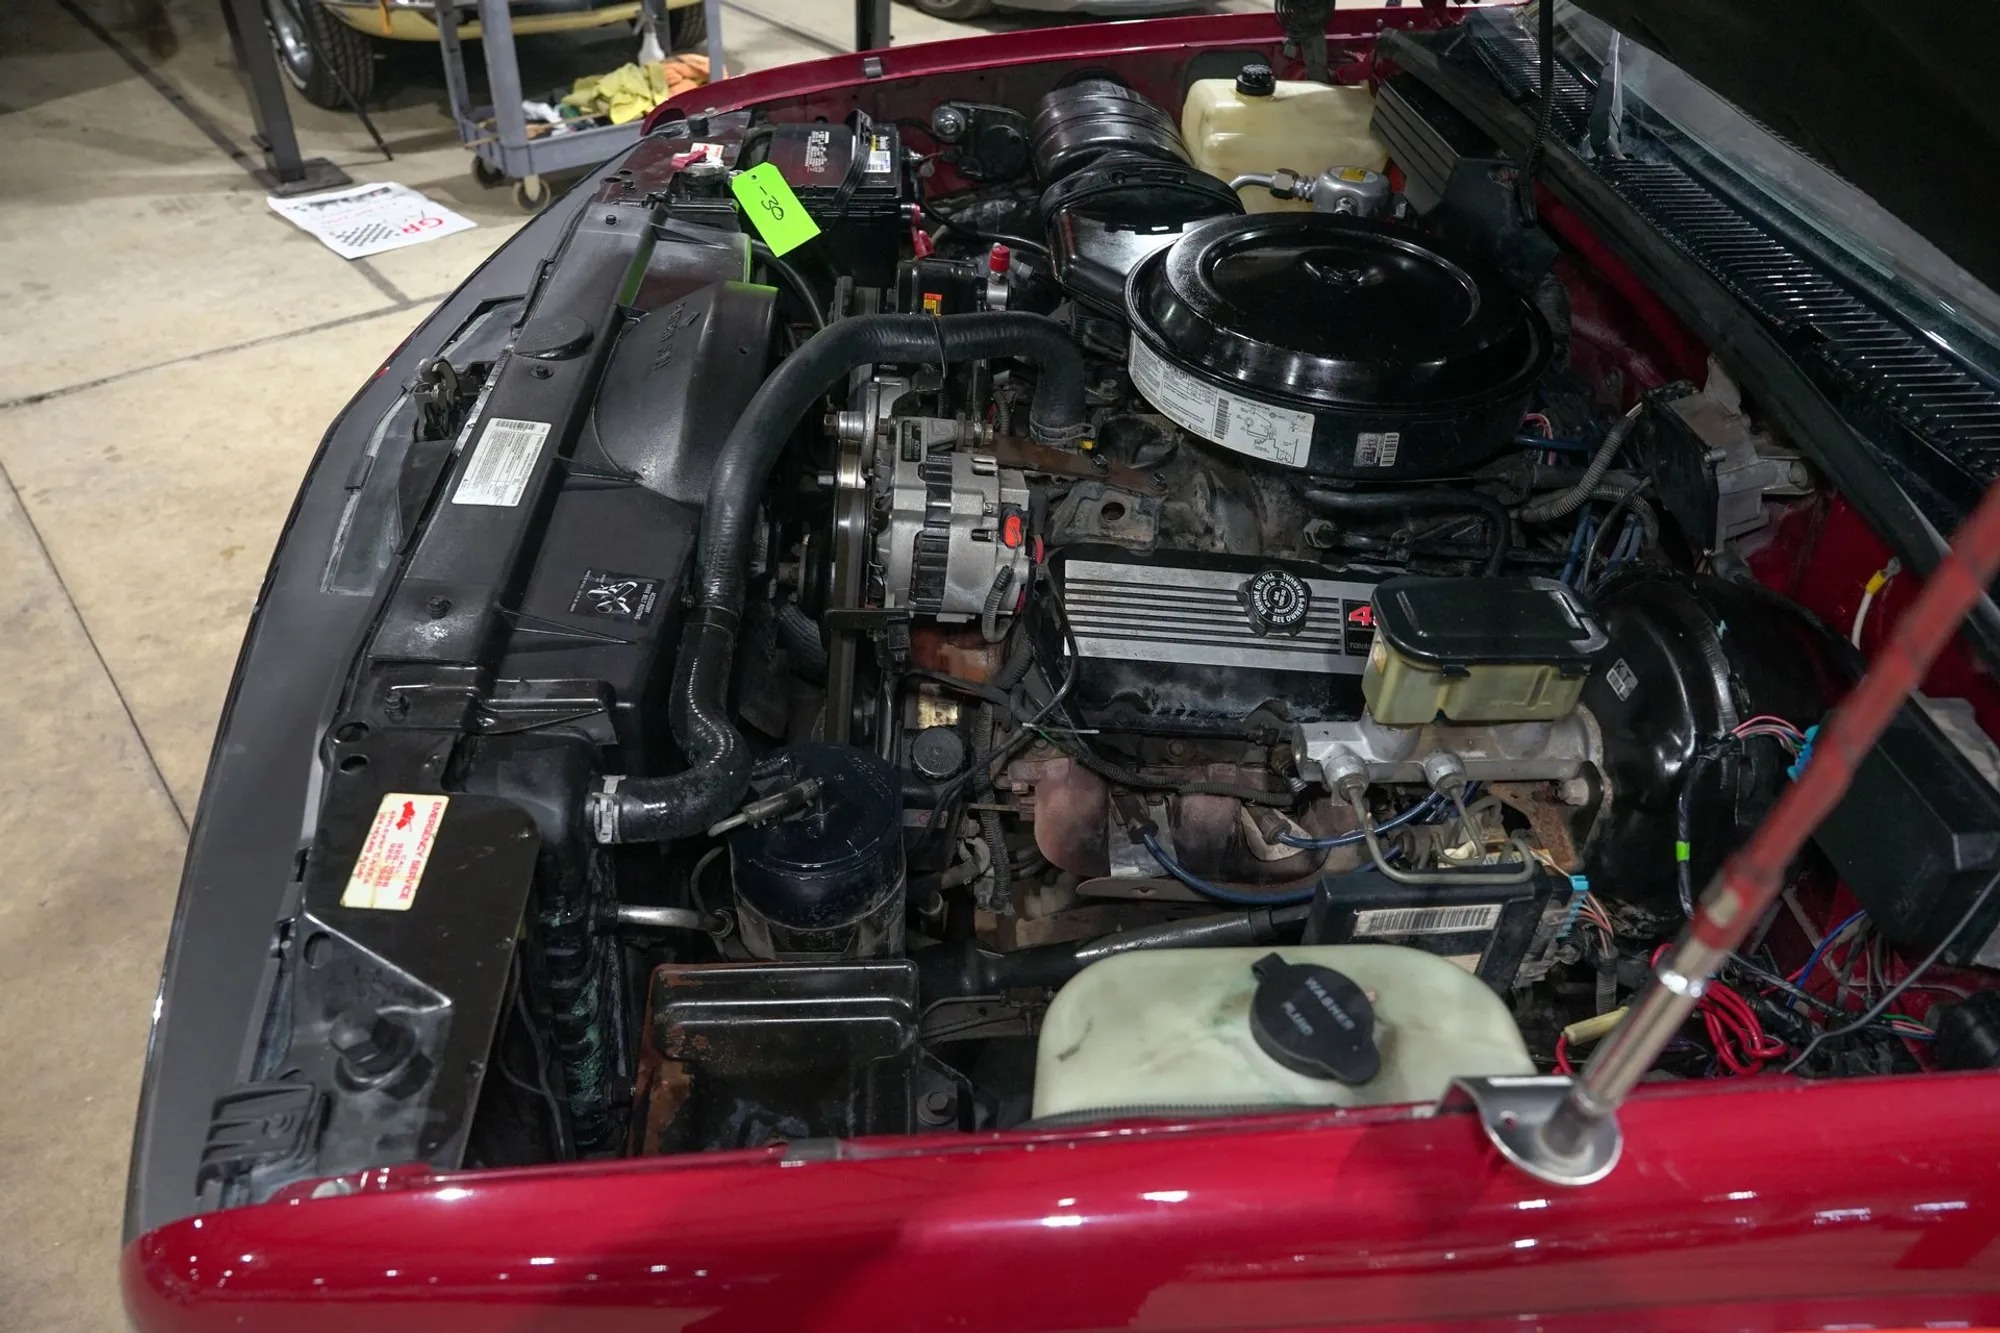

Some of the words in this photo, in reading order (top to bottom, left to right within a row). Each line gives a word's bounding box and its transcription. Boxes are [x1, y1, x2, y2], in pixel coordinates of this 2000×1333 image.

[1255, 580, 1265, 590] OIL
[1261, 572, 1276, 582] FILL
[1253, 590, 1267, 615] ENGINE
[1272, 615, 1285, 623] SEE
[1282, 572, 1305, 596] MANUAL
[414, 801, 442, 857] EMERGENCY
[398, 860, 421, 900] SERVICE
